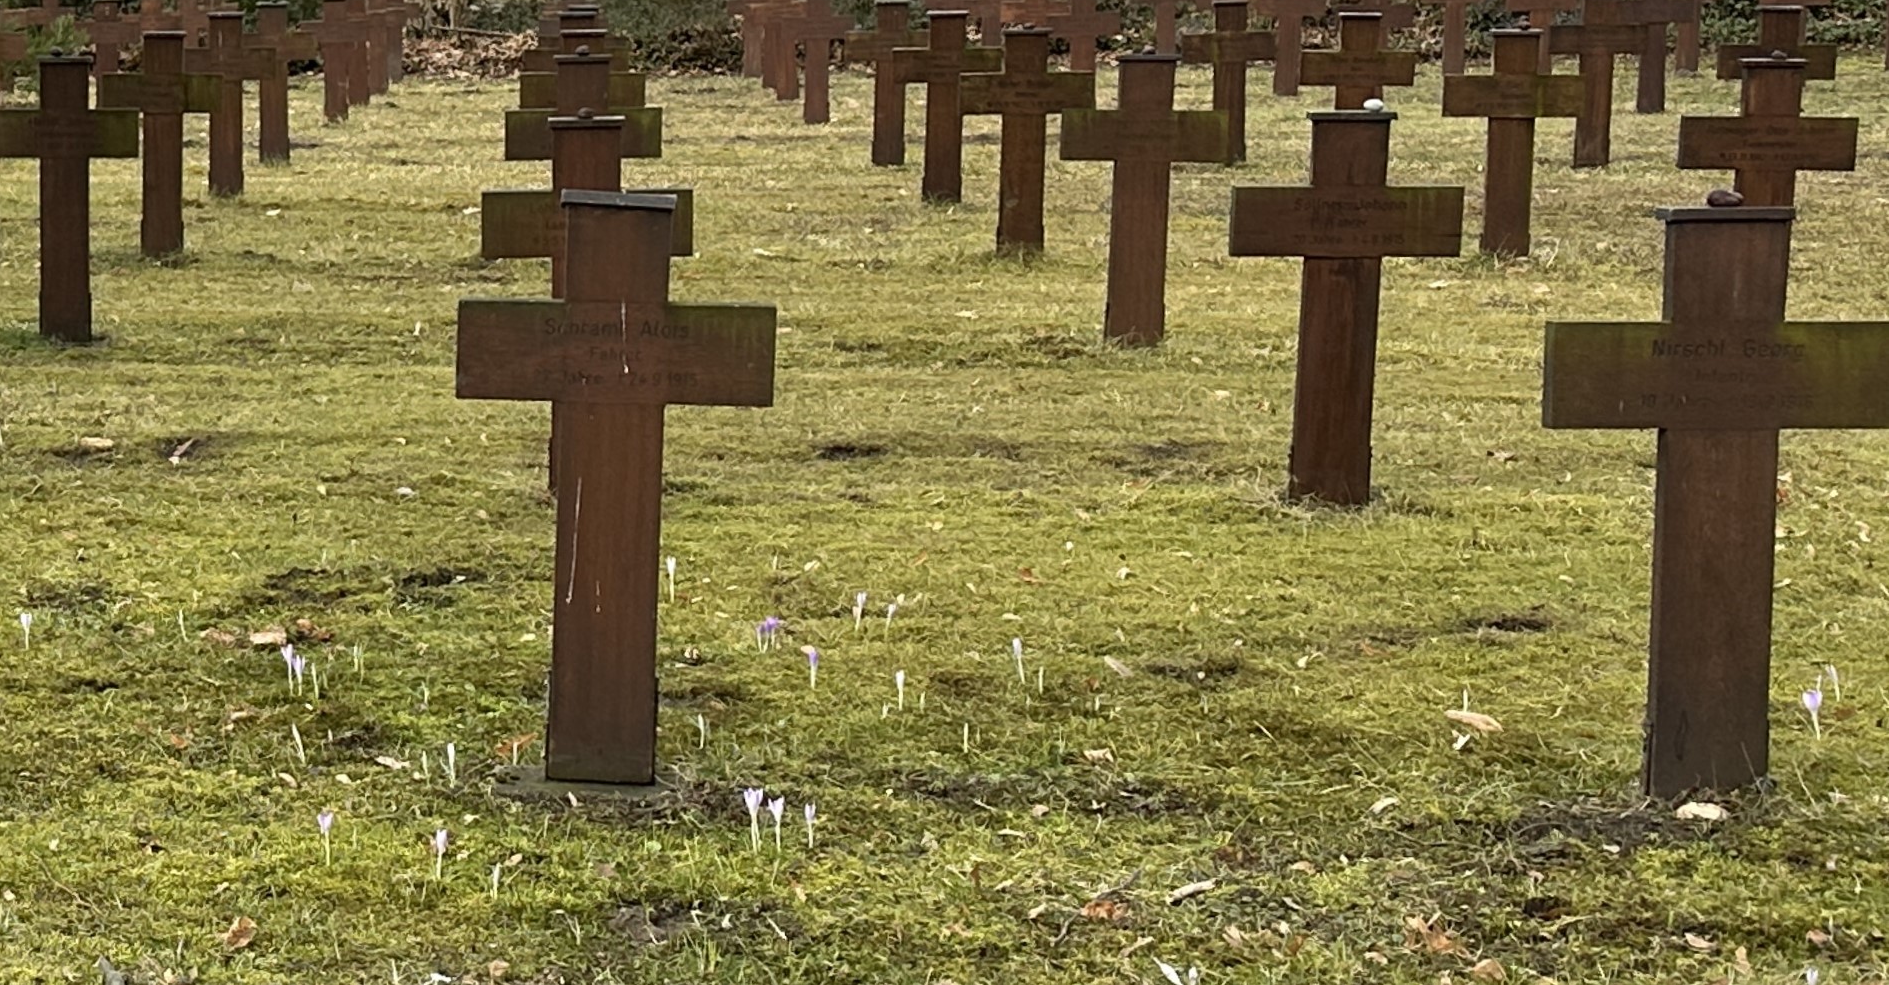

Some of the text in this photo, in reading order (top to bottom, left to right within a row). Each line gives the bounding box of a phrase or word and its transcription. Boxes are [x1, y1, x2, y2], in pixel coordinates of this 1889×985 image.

[640, 319, 690, 340] Alois
[1651, 338, 1806, 360] Nirschl Georg
